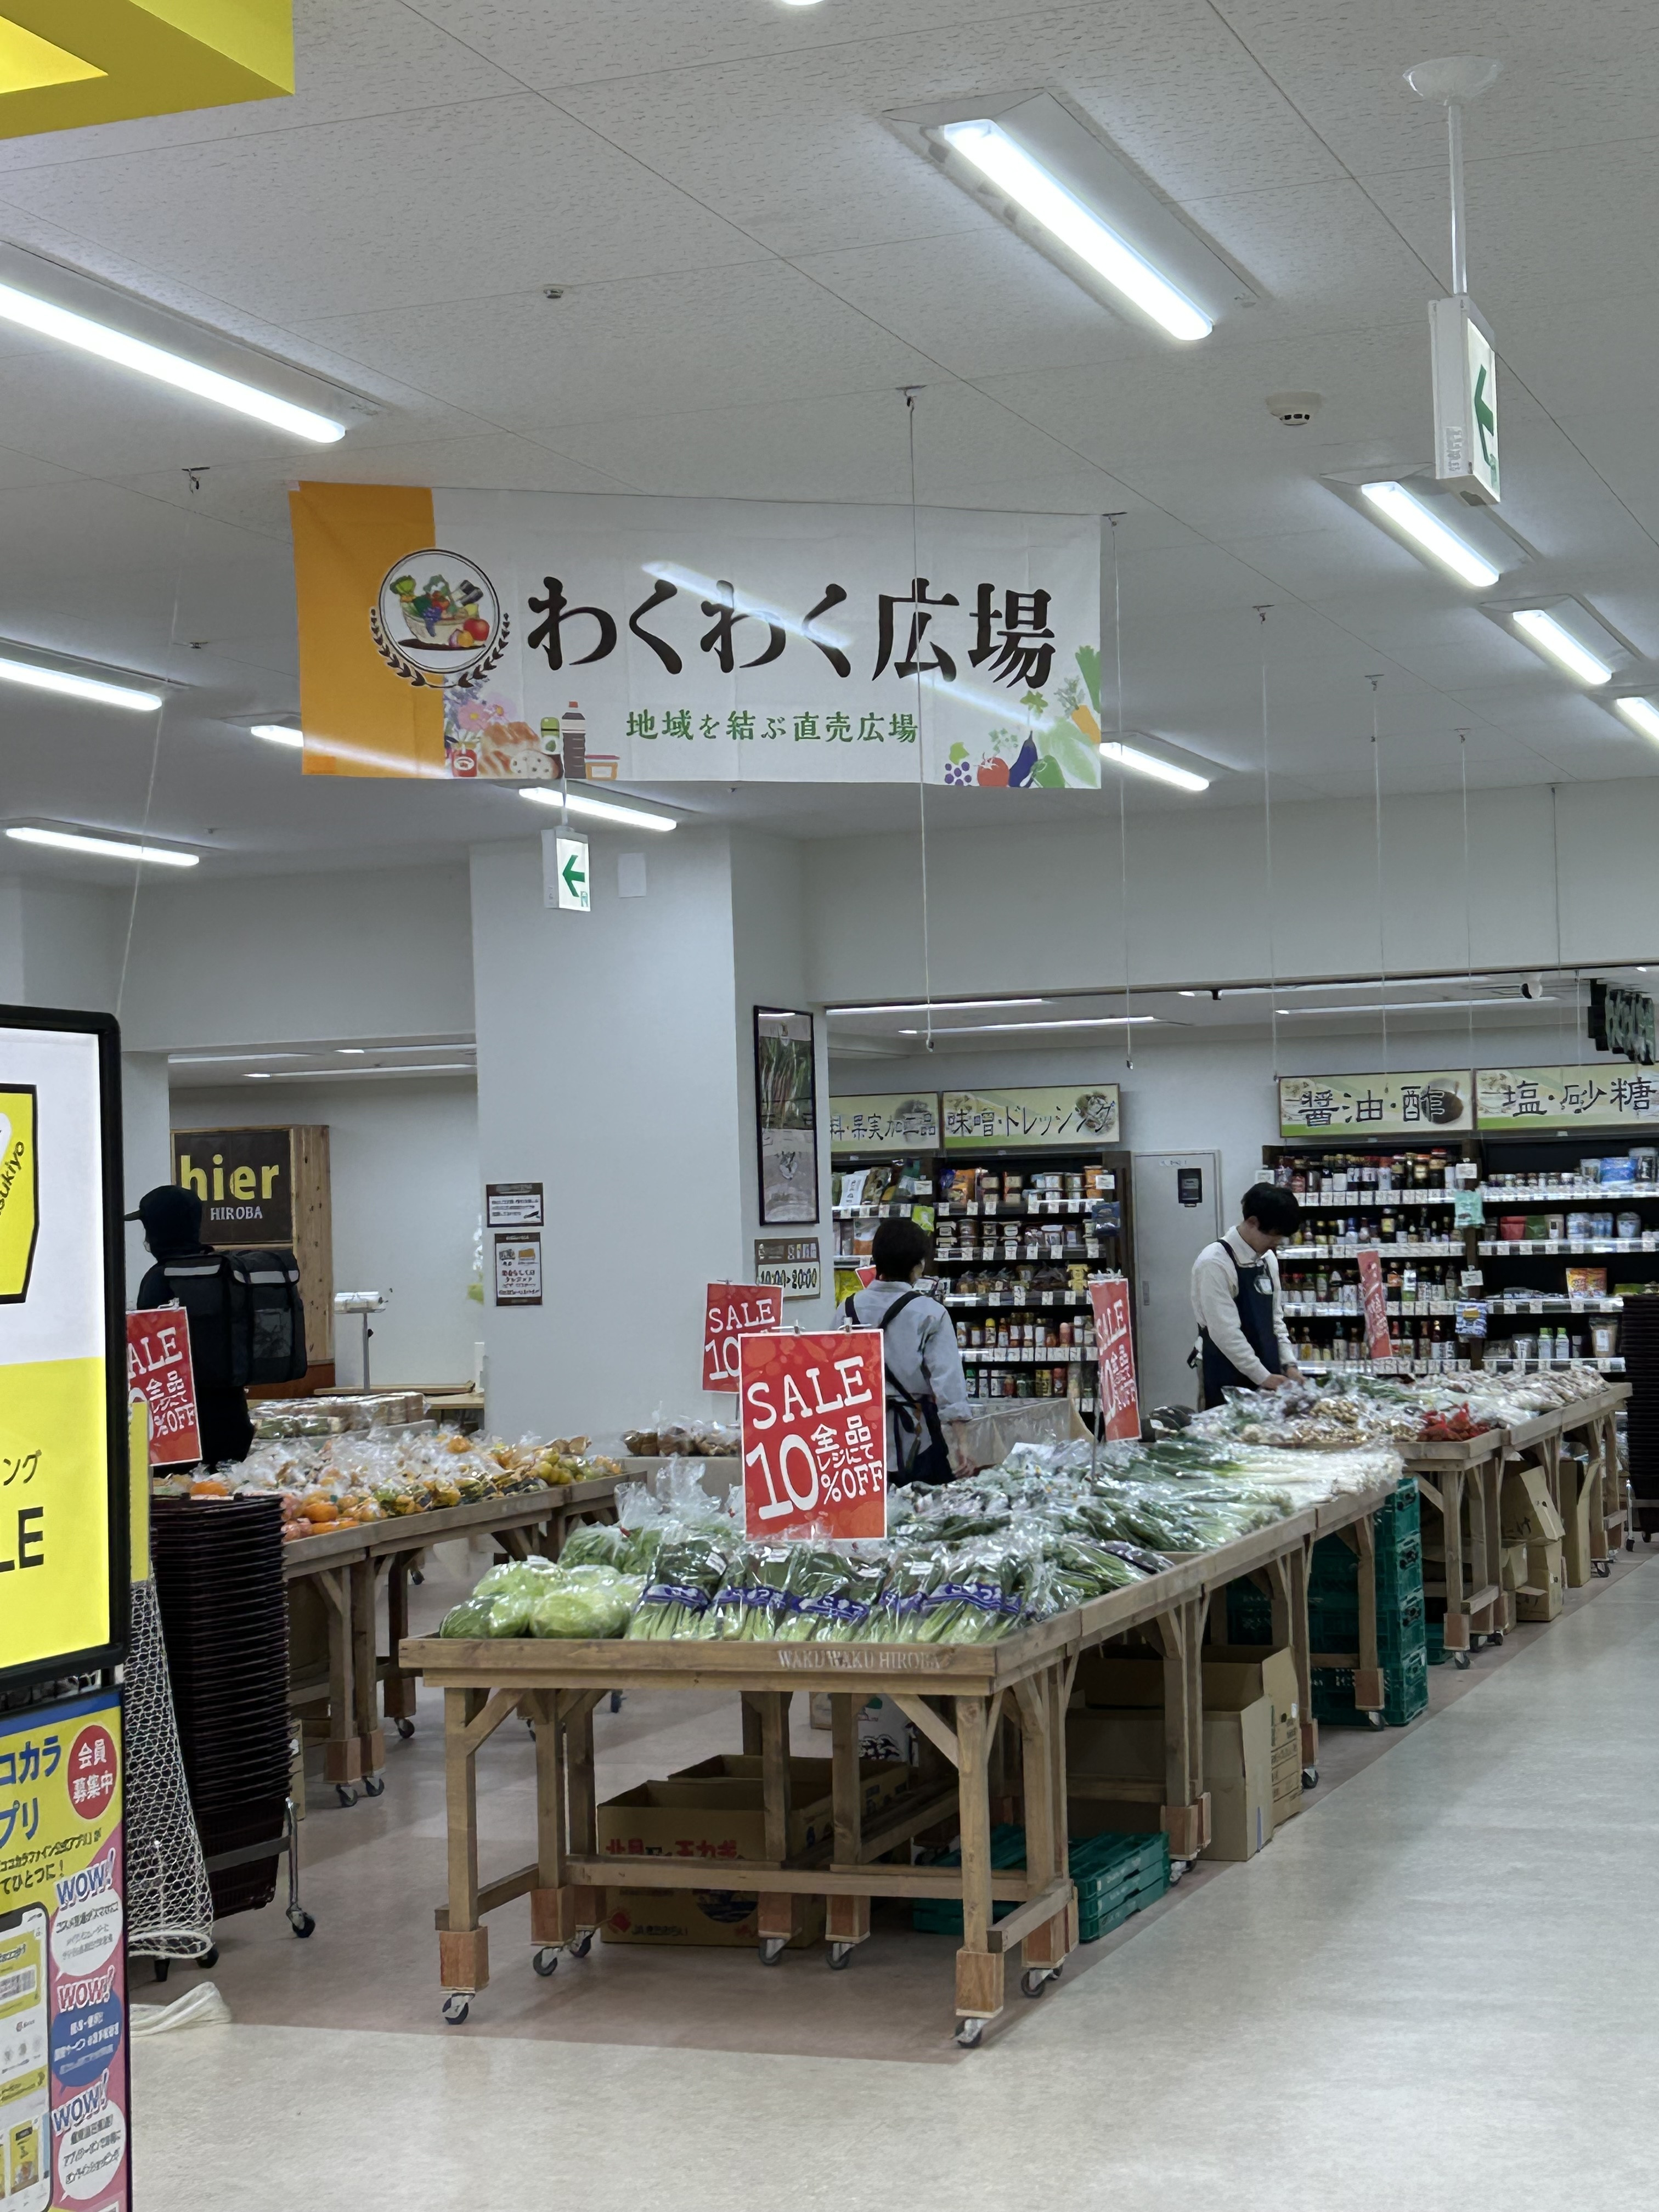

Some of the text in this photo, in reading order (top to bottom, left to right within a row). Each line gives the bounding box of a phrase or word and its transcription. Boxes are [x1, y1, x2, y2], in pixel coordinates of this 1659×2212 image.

[528, 576, 1054, 687] わくわく広場
[626, 710, 919, 745] 地域を結ぶ直売広場
[1503, 1077, 1658, 1117] 塩・砂糖
[0, 1141, 24, 1214] sukiyo
[180, 1154, 279, 1201] hier
[210, 1206, 263, 1221] HIROBA
[709, 1299, 776, 1333] SALE
[128, 1327, 182, 1379] ALE
[146, 1370, 185, 1401] 全品
[747, 1356, 873, 1430] SALE
[811, 1415, 872, 1454] 全品
[816, 1442, 875, 1472] レジにて
[3, 1449, 42, 1486] ング
[746, 1434, 820, 1521] 10
[821, 1460, 883, 1505] %OFF
[777, 1650, 823, 1669] WAKU
[825, 1650, 874, 1669] WAKU
[0, 1735, 61, 1786] コカラ
[78, 1739, 106, 1770] 会員
[72, 1770, 114, 1804] 募集中
[0, 1797, 40, 1849] プリ
[57, 1847, 116, 1908] WOW!
[57, 1965, 115, 2013] WOW!
[52, 2068, 110, 2136] WOW!
